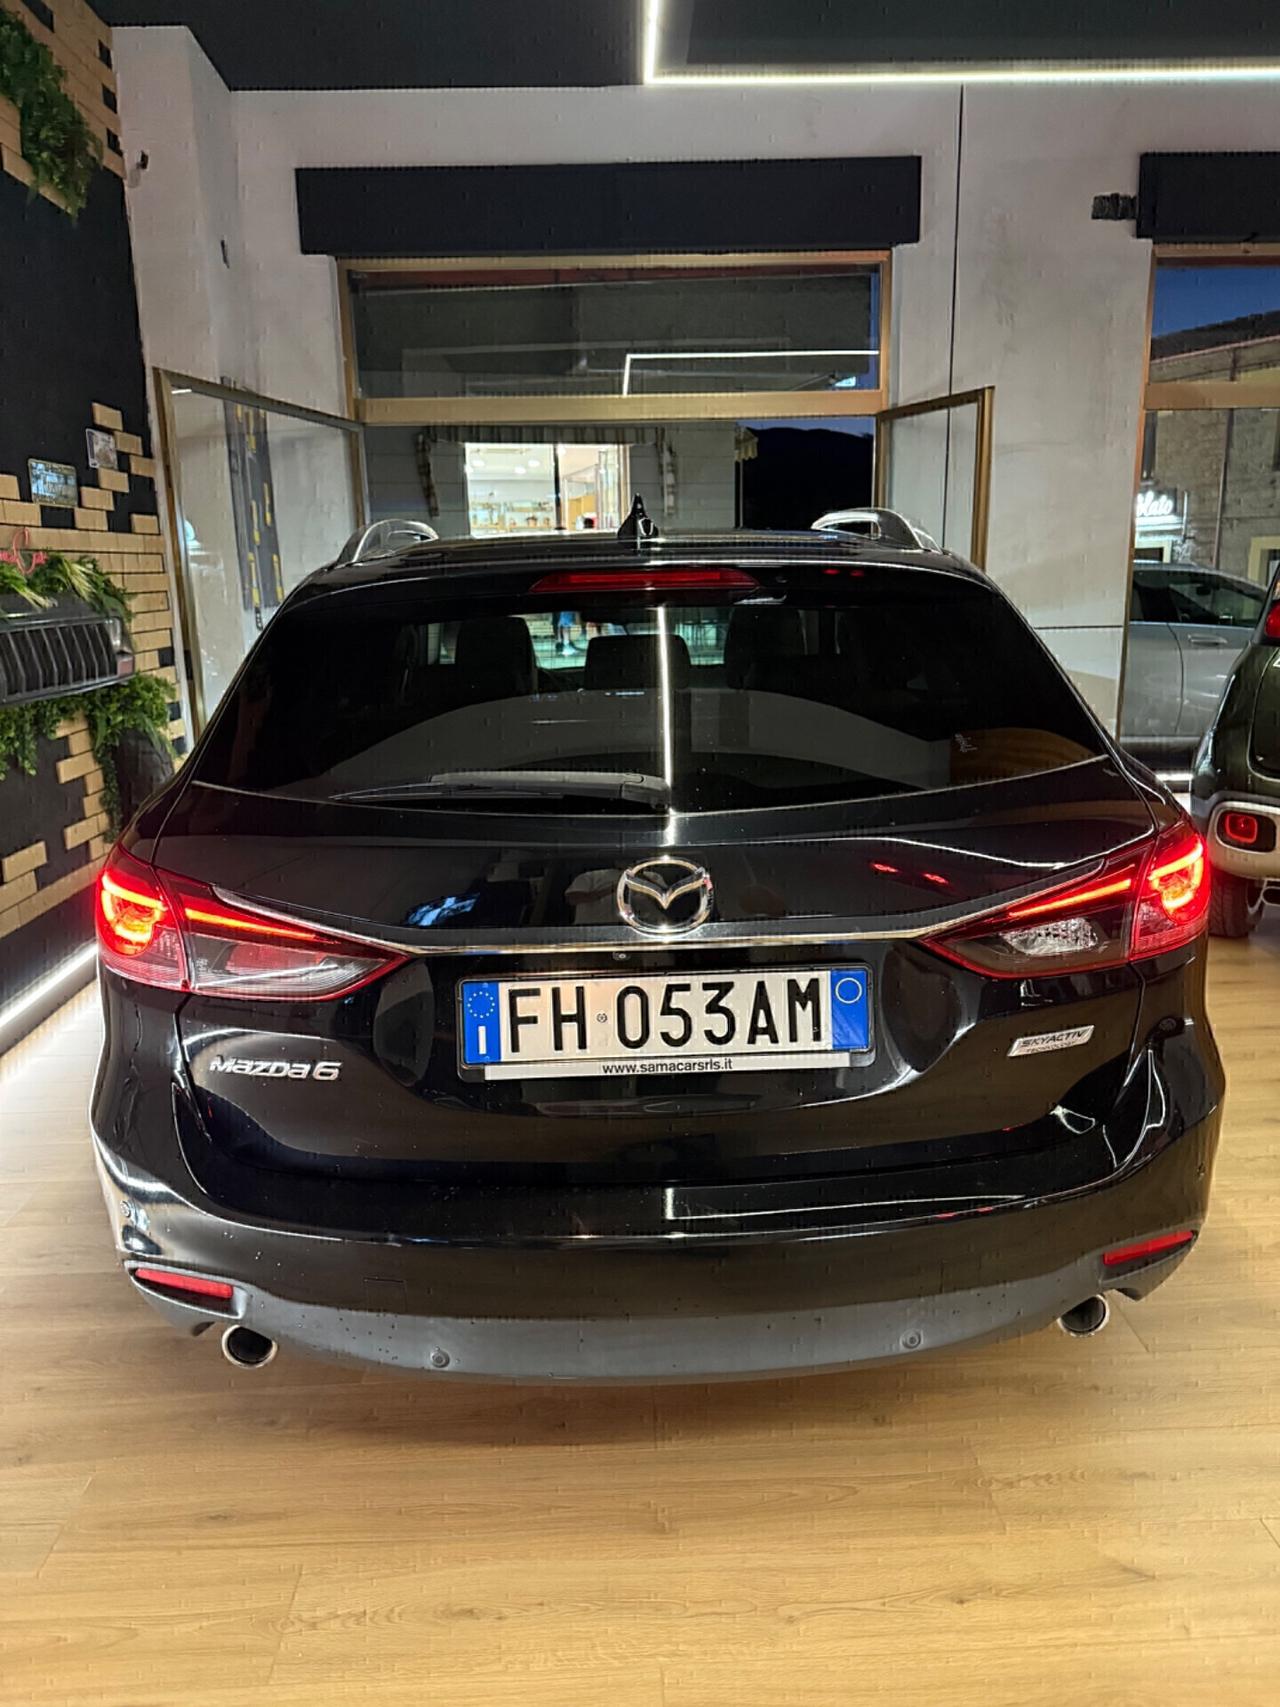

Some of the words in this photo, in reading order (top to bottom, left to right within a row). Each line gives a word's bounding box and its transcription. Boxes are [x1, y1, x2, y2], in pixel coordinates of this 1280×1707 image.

[509, 986, 587, 1053] FH
[617, 978, 822, 1049] 053AM
[1020, 1030, 1087, 1048] SKYACTIV
[602, 1058, 733, 1074] www.samacarsrls.it
